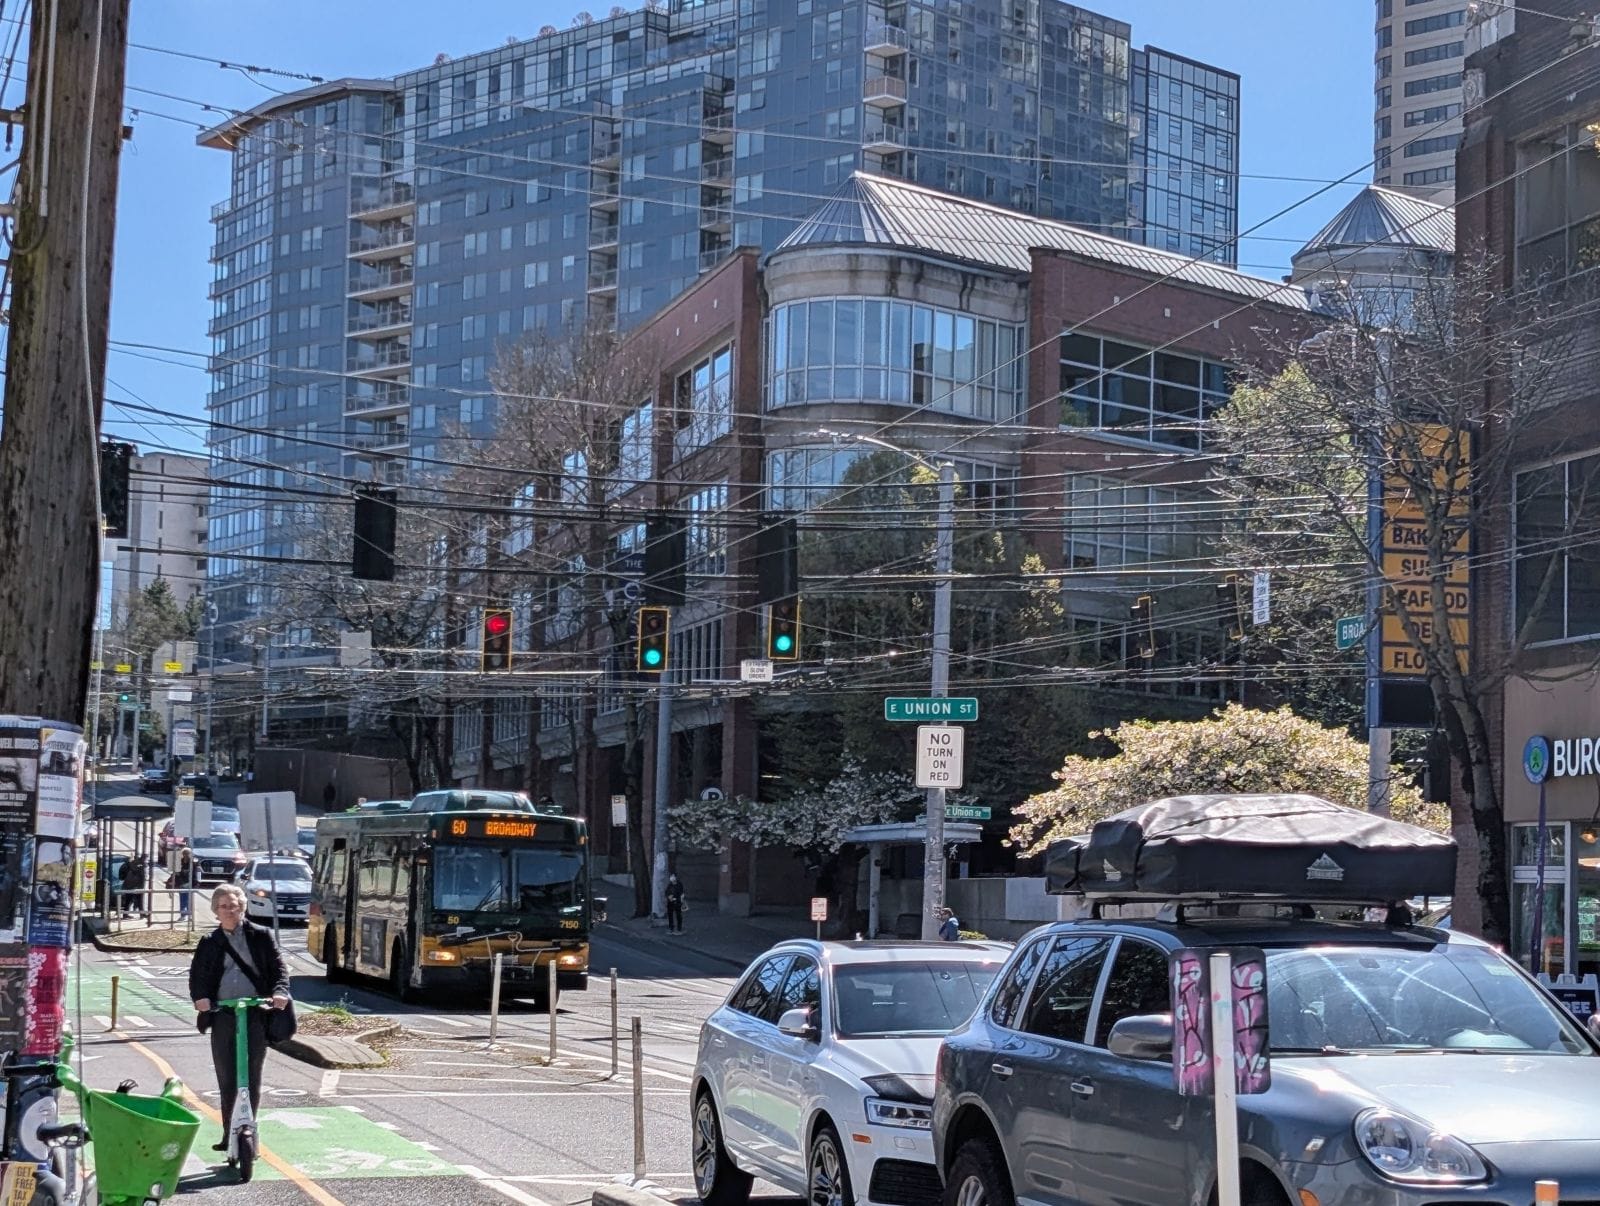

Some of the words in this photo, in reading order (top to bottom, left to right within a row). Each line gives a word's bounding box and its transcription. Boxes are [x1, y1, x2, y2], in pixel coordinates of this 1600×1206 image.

[1386, 589, 1467, 609] SEAFOD
[890, 704, 897, 713] E
[905, 702, 951, 715] UNION
[959, 704, 973, 714] ST
[930, 733, 951, 745] NO
[927, 747, 953, 758] TURN
[932, 760, 947, 769] ON
[929, 772, 950, 781] RED
[952, 807, 974, 817] Union
[452, 820, 467, 835] 60
[485, 821, 537, 837] BROADWAY
